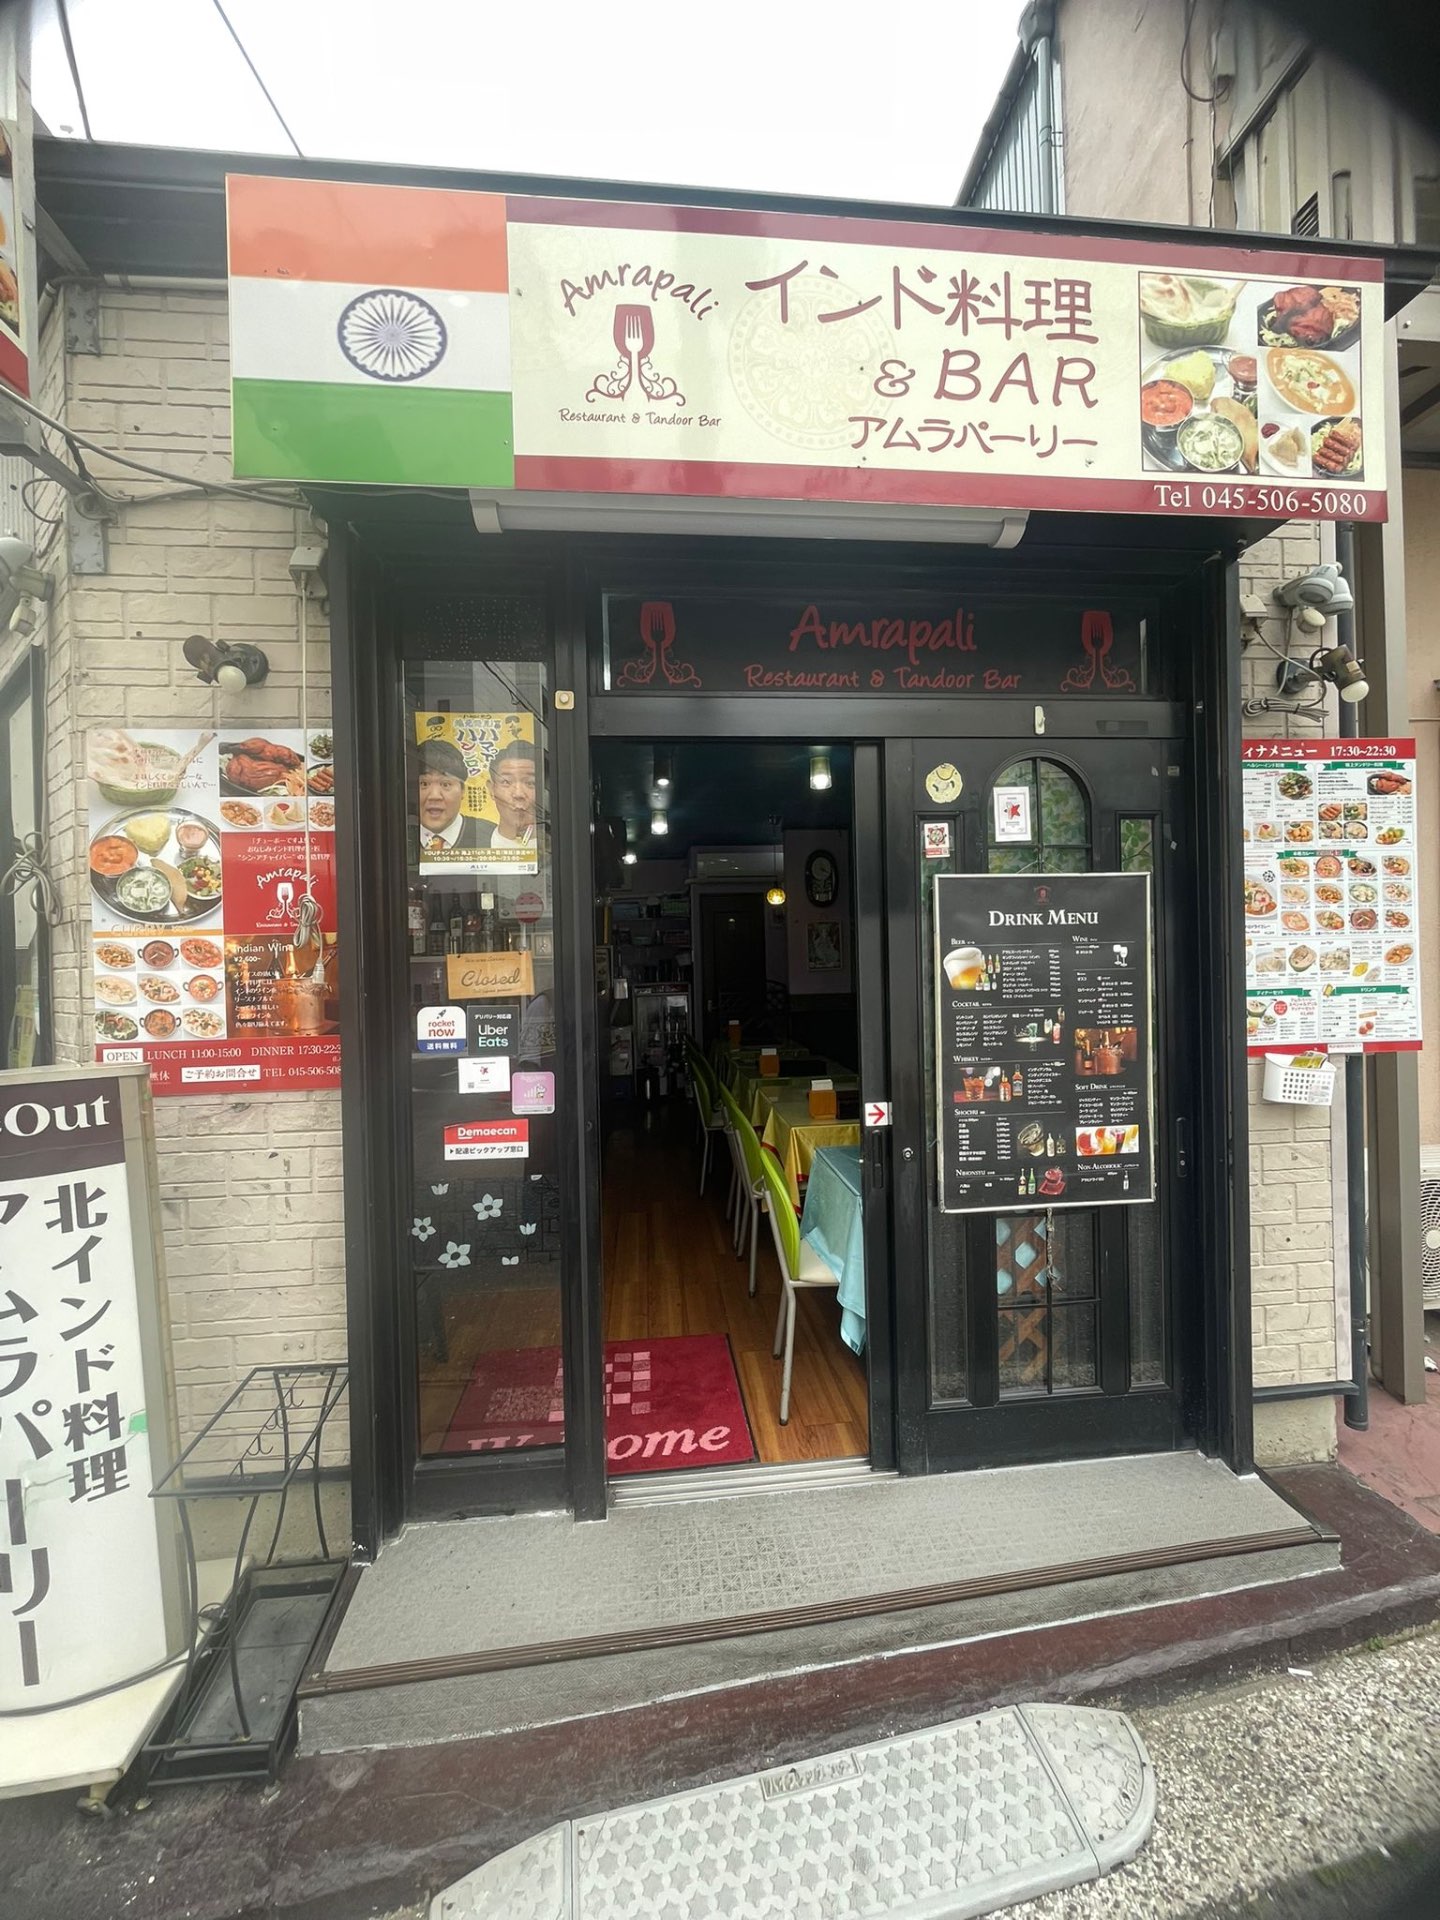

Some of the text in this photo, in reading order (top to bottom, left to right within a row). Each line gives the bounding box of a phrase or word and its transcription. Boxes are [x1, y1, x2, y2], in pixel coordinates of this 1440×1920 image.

[559, 263, 720, 321] Amrapali
[745, 259, 1099, 345] インド料理
[874, 349, 1099, 409] & BAR
[558, 407, 722, 428] Restaurant & Tandoor Bar
[848, 415, 1099, 458] アムラパーリー
[1153, 484, 1367, 515] Tel 045-506-5080
[788, 604, 978, 666] Amrapali
[743, 663, 1022, 690] Restaurant & Tandoor Bar
[988, 908, 1099, 927] DRINK MENU
[461, 967, 521, 988] Closed
[428, 1029, 455, 1037] now
[478, 1024, 509, 1036] Uber
[478, 1036, 509, 1047] Eats
[107, 1052, 139, 1062] OPEN
[147, 1049, 187, 1060] LUNCH
[251, 1045, 294, 1057] DINNER
[263, 1067, 286, 1079] TEL
[0, 1094, 110, 1137] Out
[457, 1127, 517, 1137] Demaecan
[44, 1181, 130, 1504] 北インド料理
